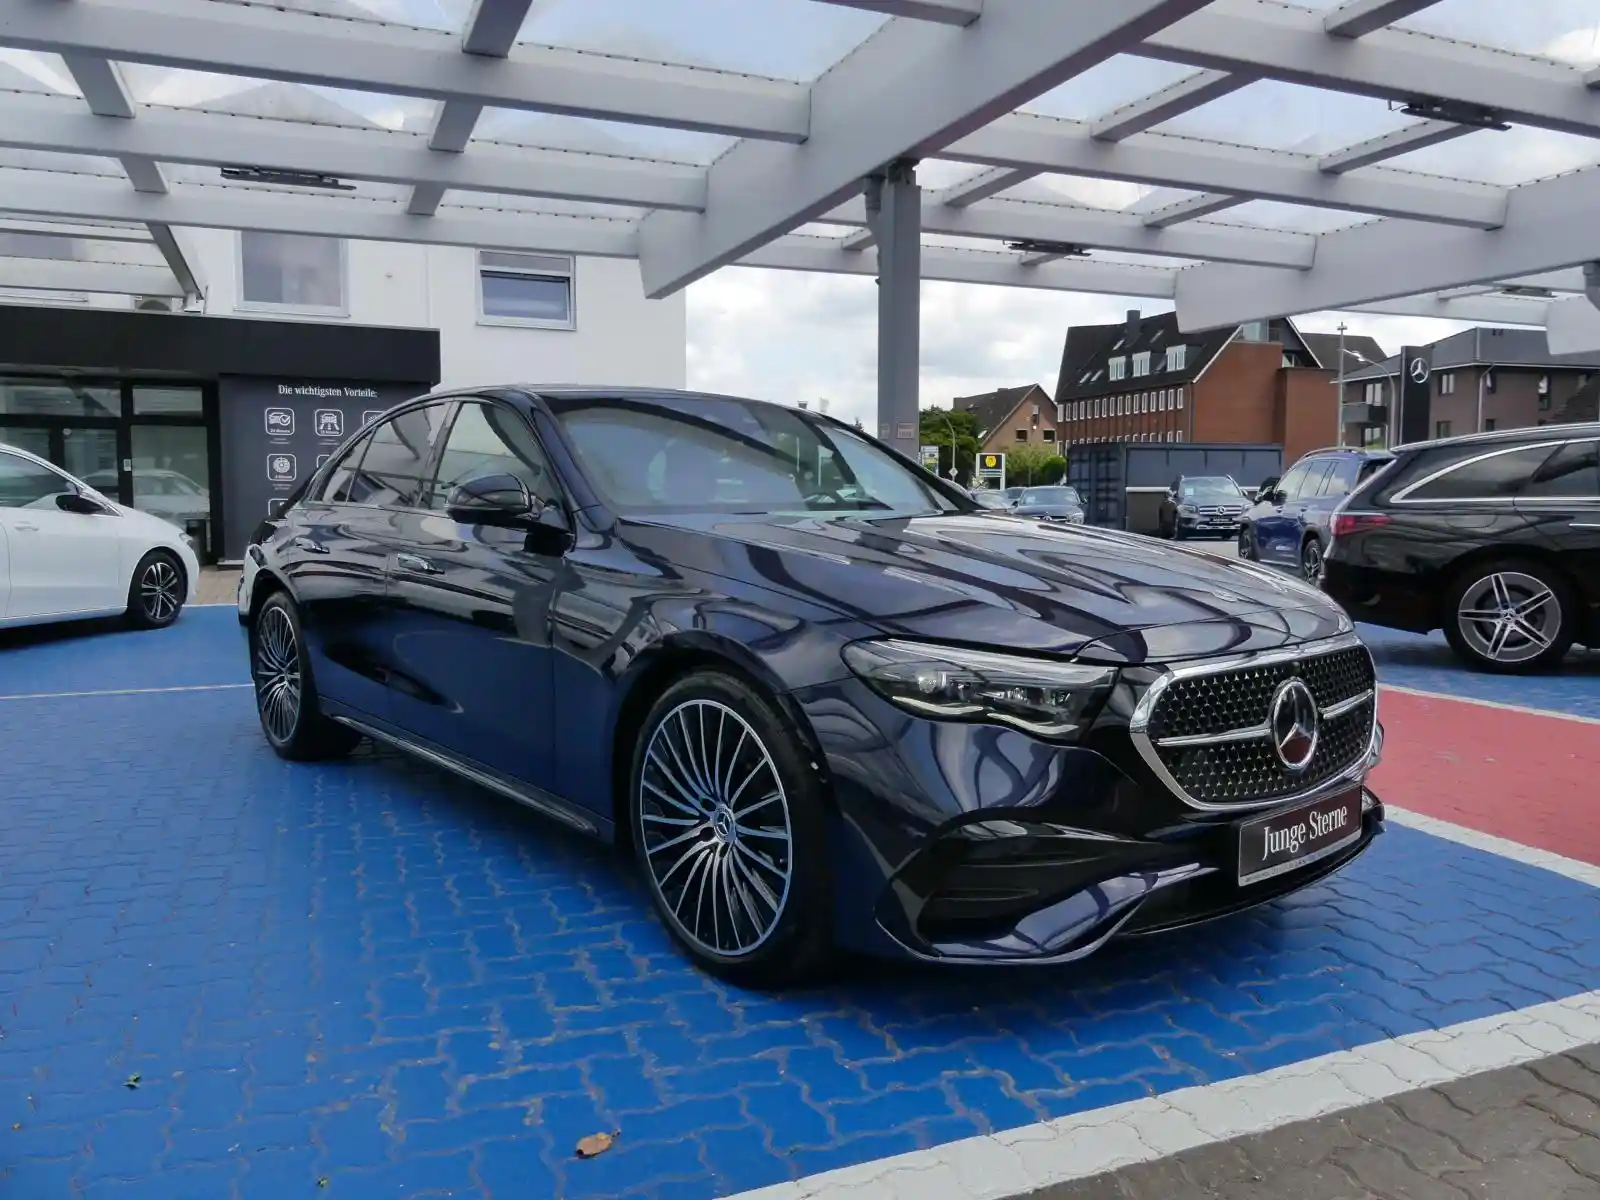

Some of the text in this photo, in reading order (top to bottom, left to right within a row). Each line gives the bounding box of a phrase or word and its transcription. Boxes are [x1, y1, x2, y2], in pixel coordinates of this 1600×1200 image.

[278, 385, 293, 394] Die
[295, 386, 342, 398] wichtigsten
[1262, 806, 1348, 861] Junge Sterne
